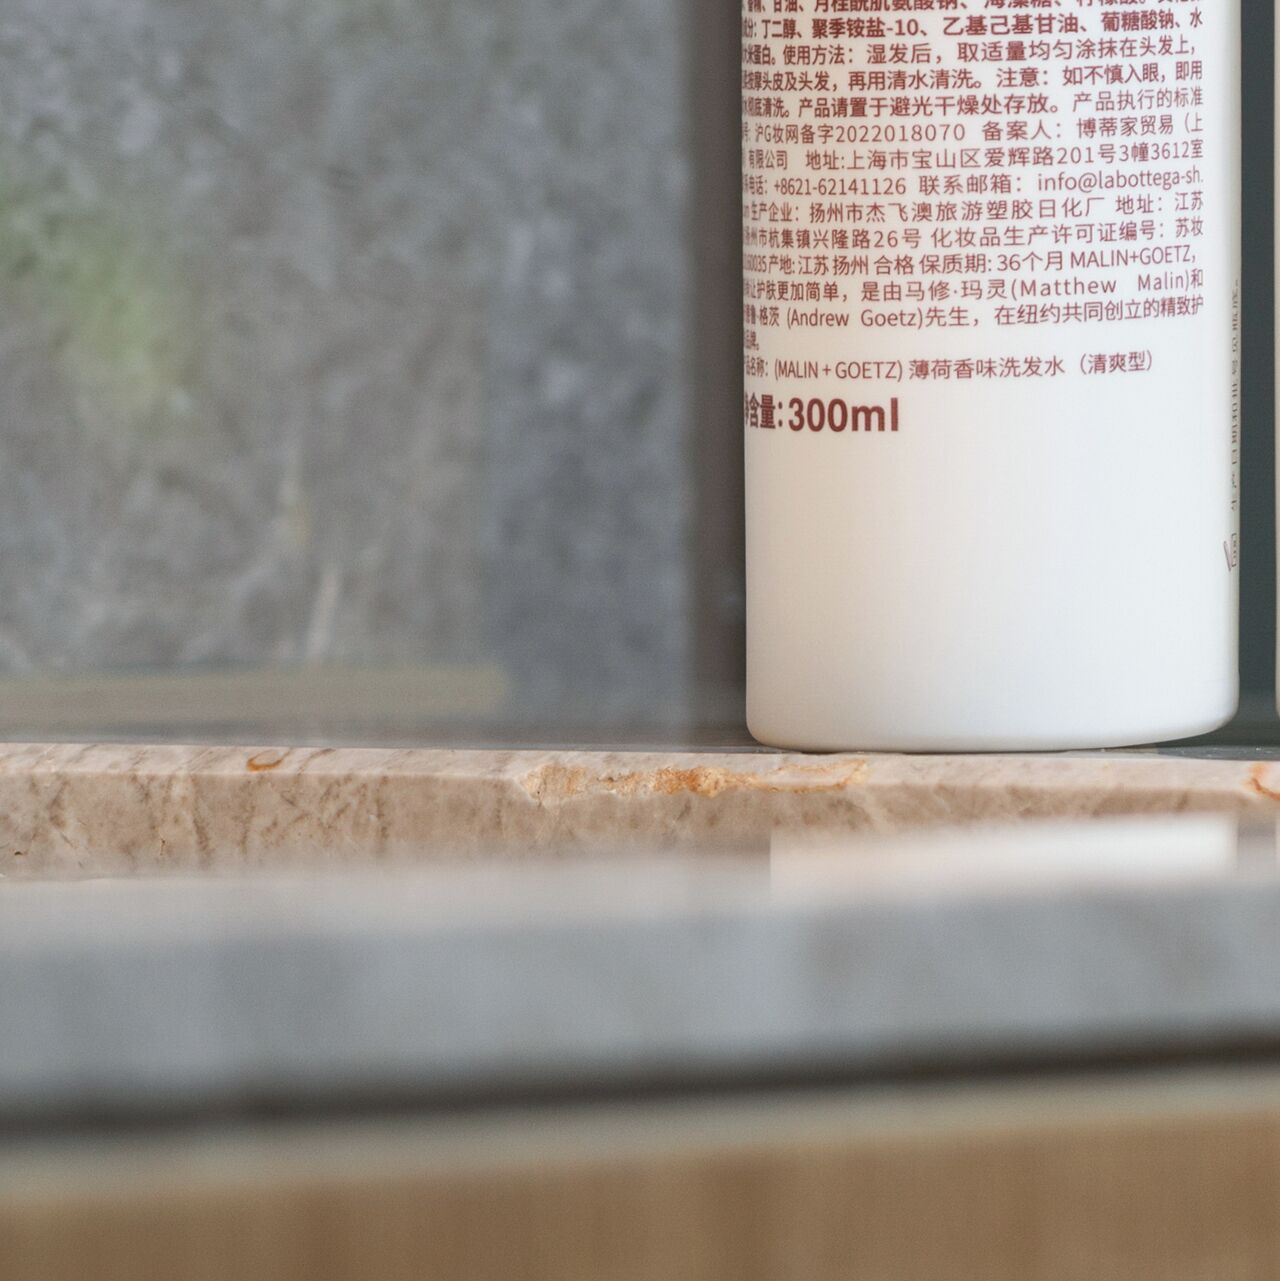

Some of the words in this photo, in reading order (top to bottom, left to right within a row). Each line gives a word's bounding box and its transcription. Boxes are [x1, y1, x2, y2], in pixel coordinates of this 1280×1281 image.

[773, 176, 907, 197] +8621-62141126
[1037, 164, 1204, 194] info@labottega-sh.
[797, 252, 830, 277] 江苏
[831, 253, 869, 277] 扬州
[873, 253, 916, 277] 合格
[996, 249, 1064, 273] 36个月
[786, 306, 850, 331] (Andrew
[774, 357, 819, 383] (MALIN
[821, 363, 832, 377] +
[834, 359, 903, 384] GOETZ)
